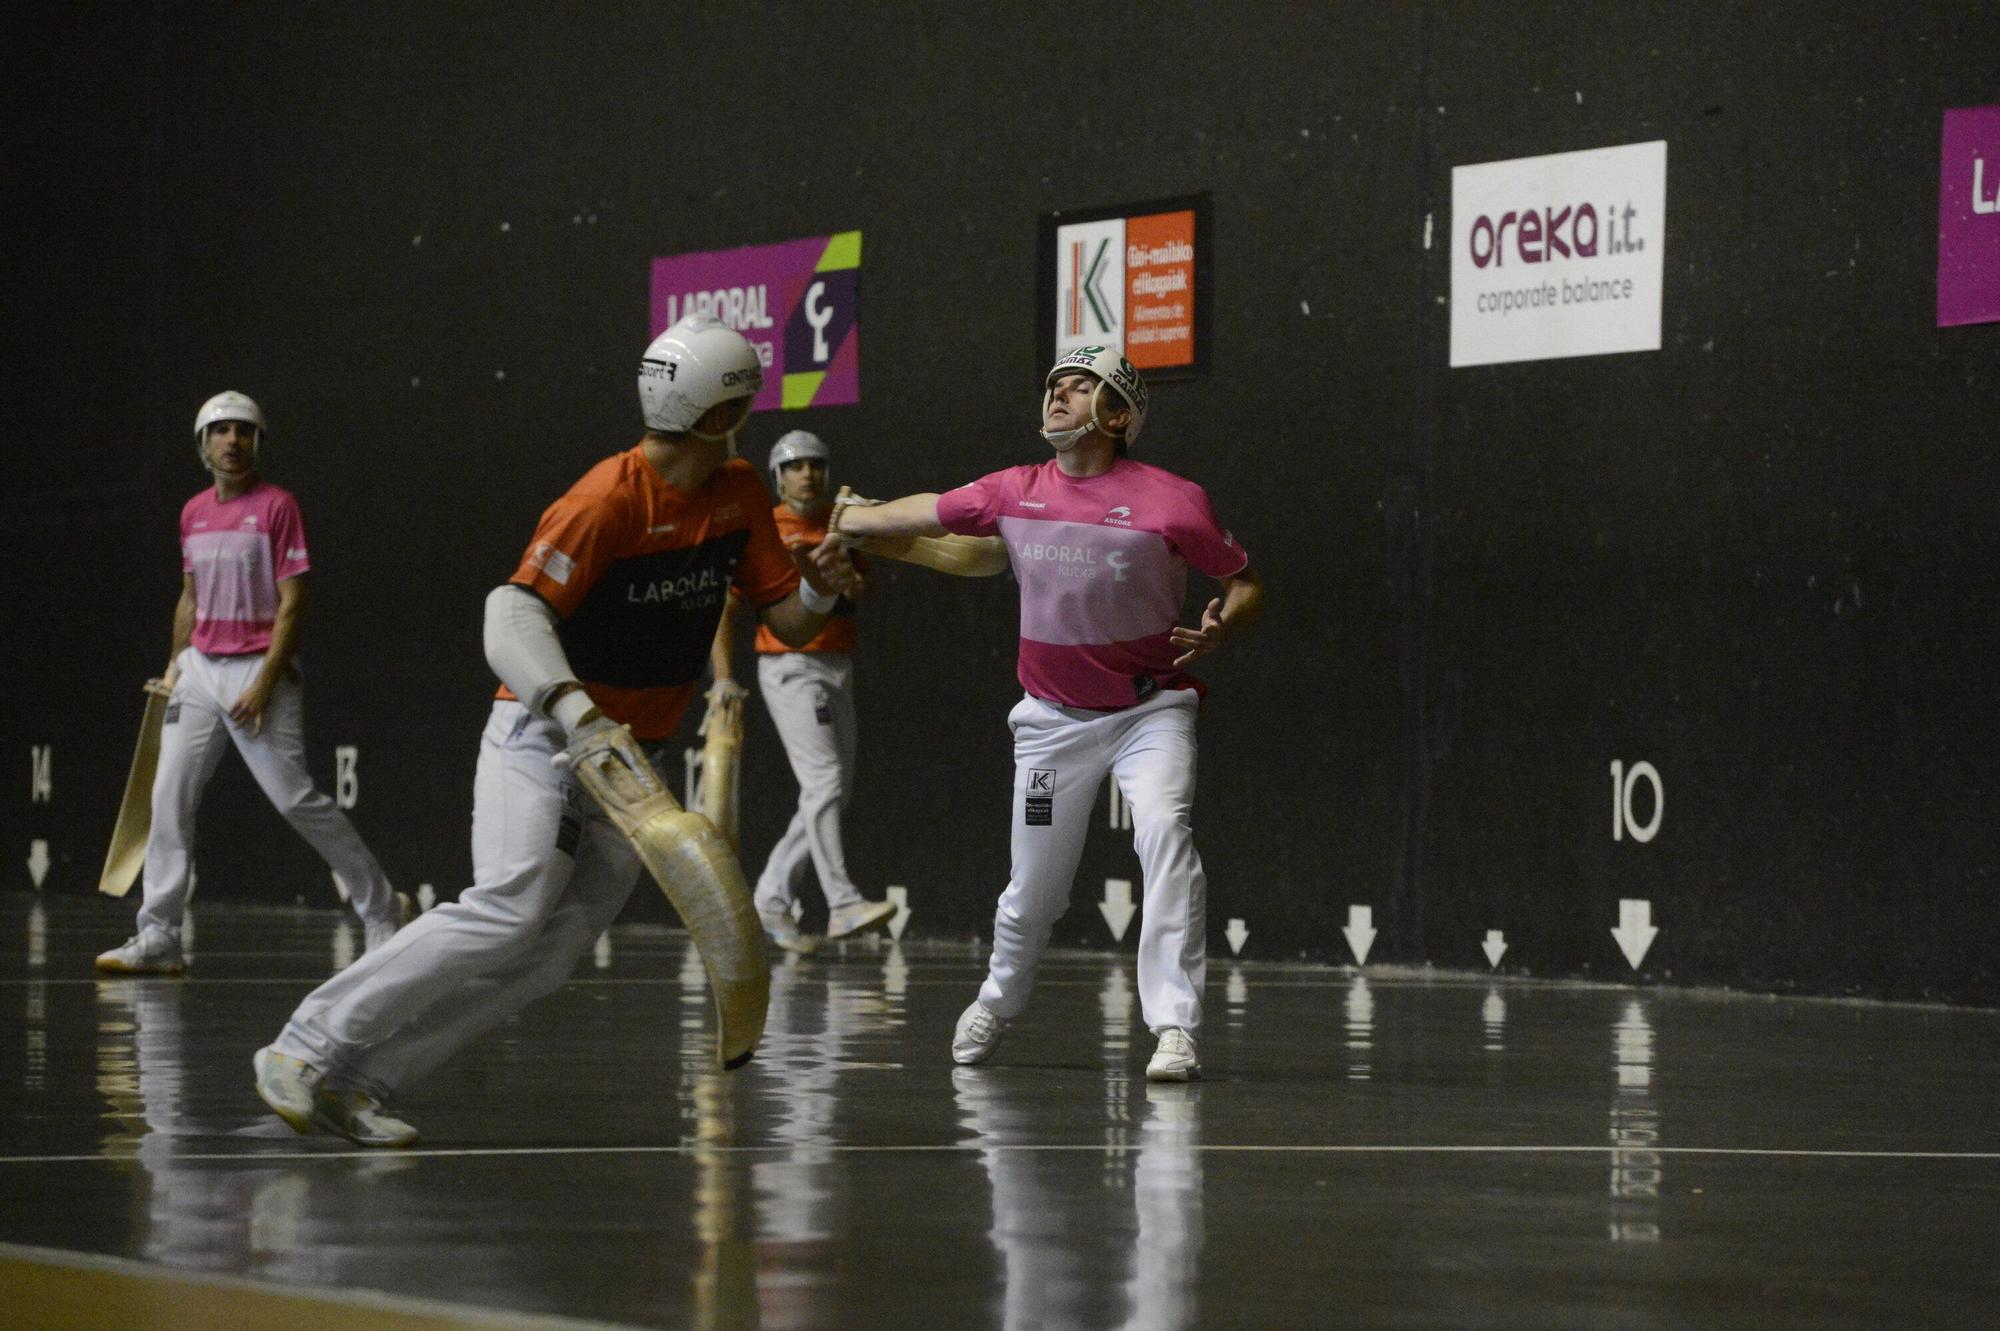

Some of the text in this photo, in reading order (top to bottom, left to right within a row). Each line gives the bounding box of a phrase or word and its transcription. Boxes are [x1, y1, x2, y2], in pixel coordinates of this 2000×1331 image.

[1972, 158, 2000, 215] L
[1469, 202, 1598, 268] oreka
[1477, 275, 1633, 316] corporate balance
[1104, 517, 1133, 527] ASTORE
[1015, 542, 1097, 564] LABORAL
[1610, 758, 1664, 843] 10
